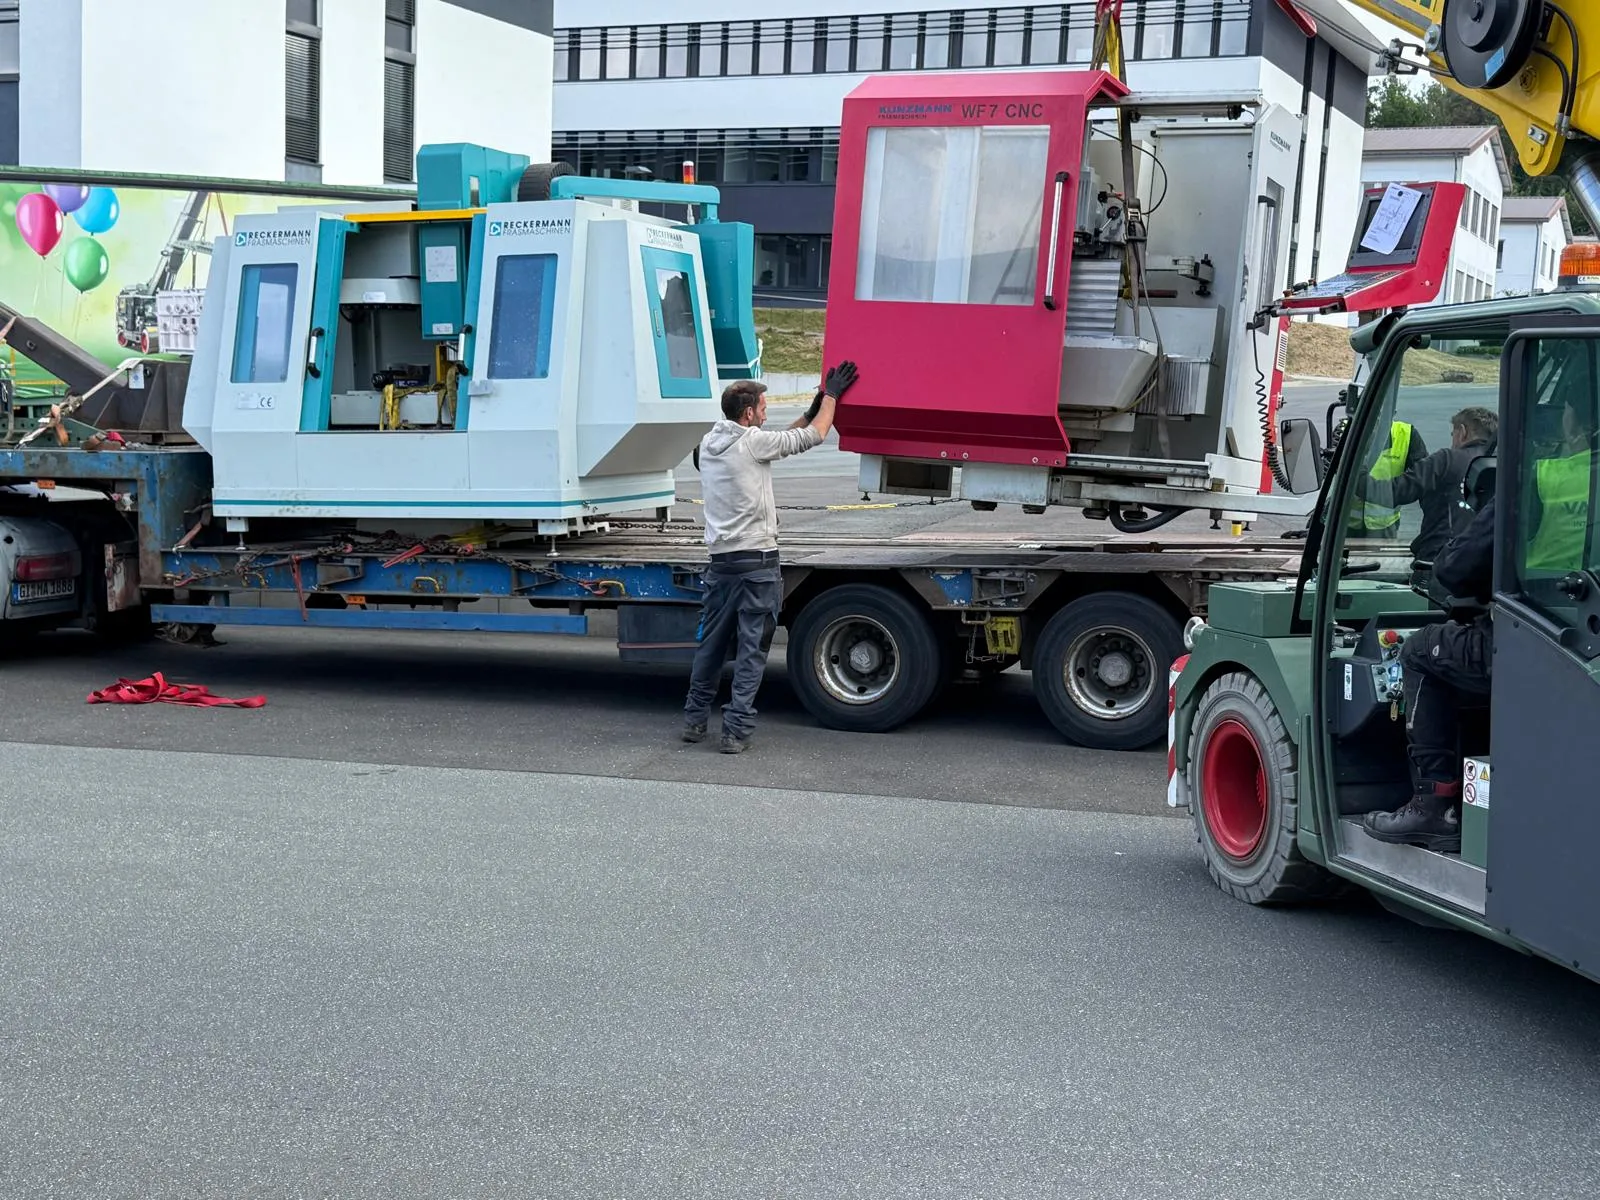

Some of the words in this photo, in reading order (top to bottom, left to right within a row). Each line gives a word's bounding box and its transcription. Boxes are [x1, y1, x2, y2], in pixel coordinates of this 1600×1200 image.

[1005, 104, 1043, 118] CNC
[503, 219, 571, 229] RECKERMANN
[248, 229, 311, 239] RECKERMANN
[260, 396, 273, 408] CE
